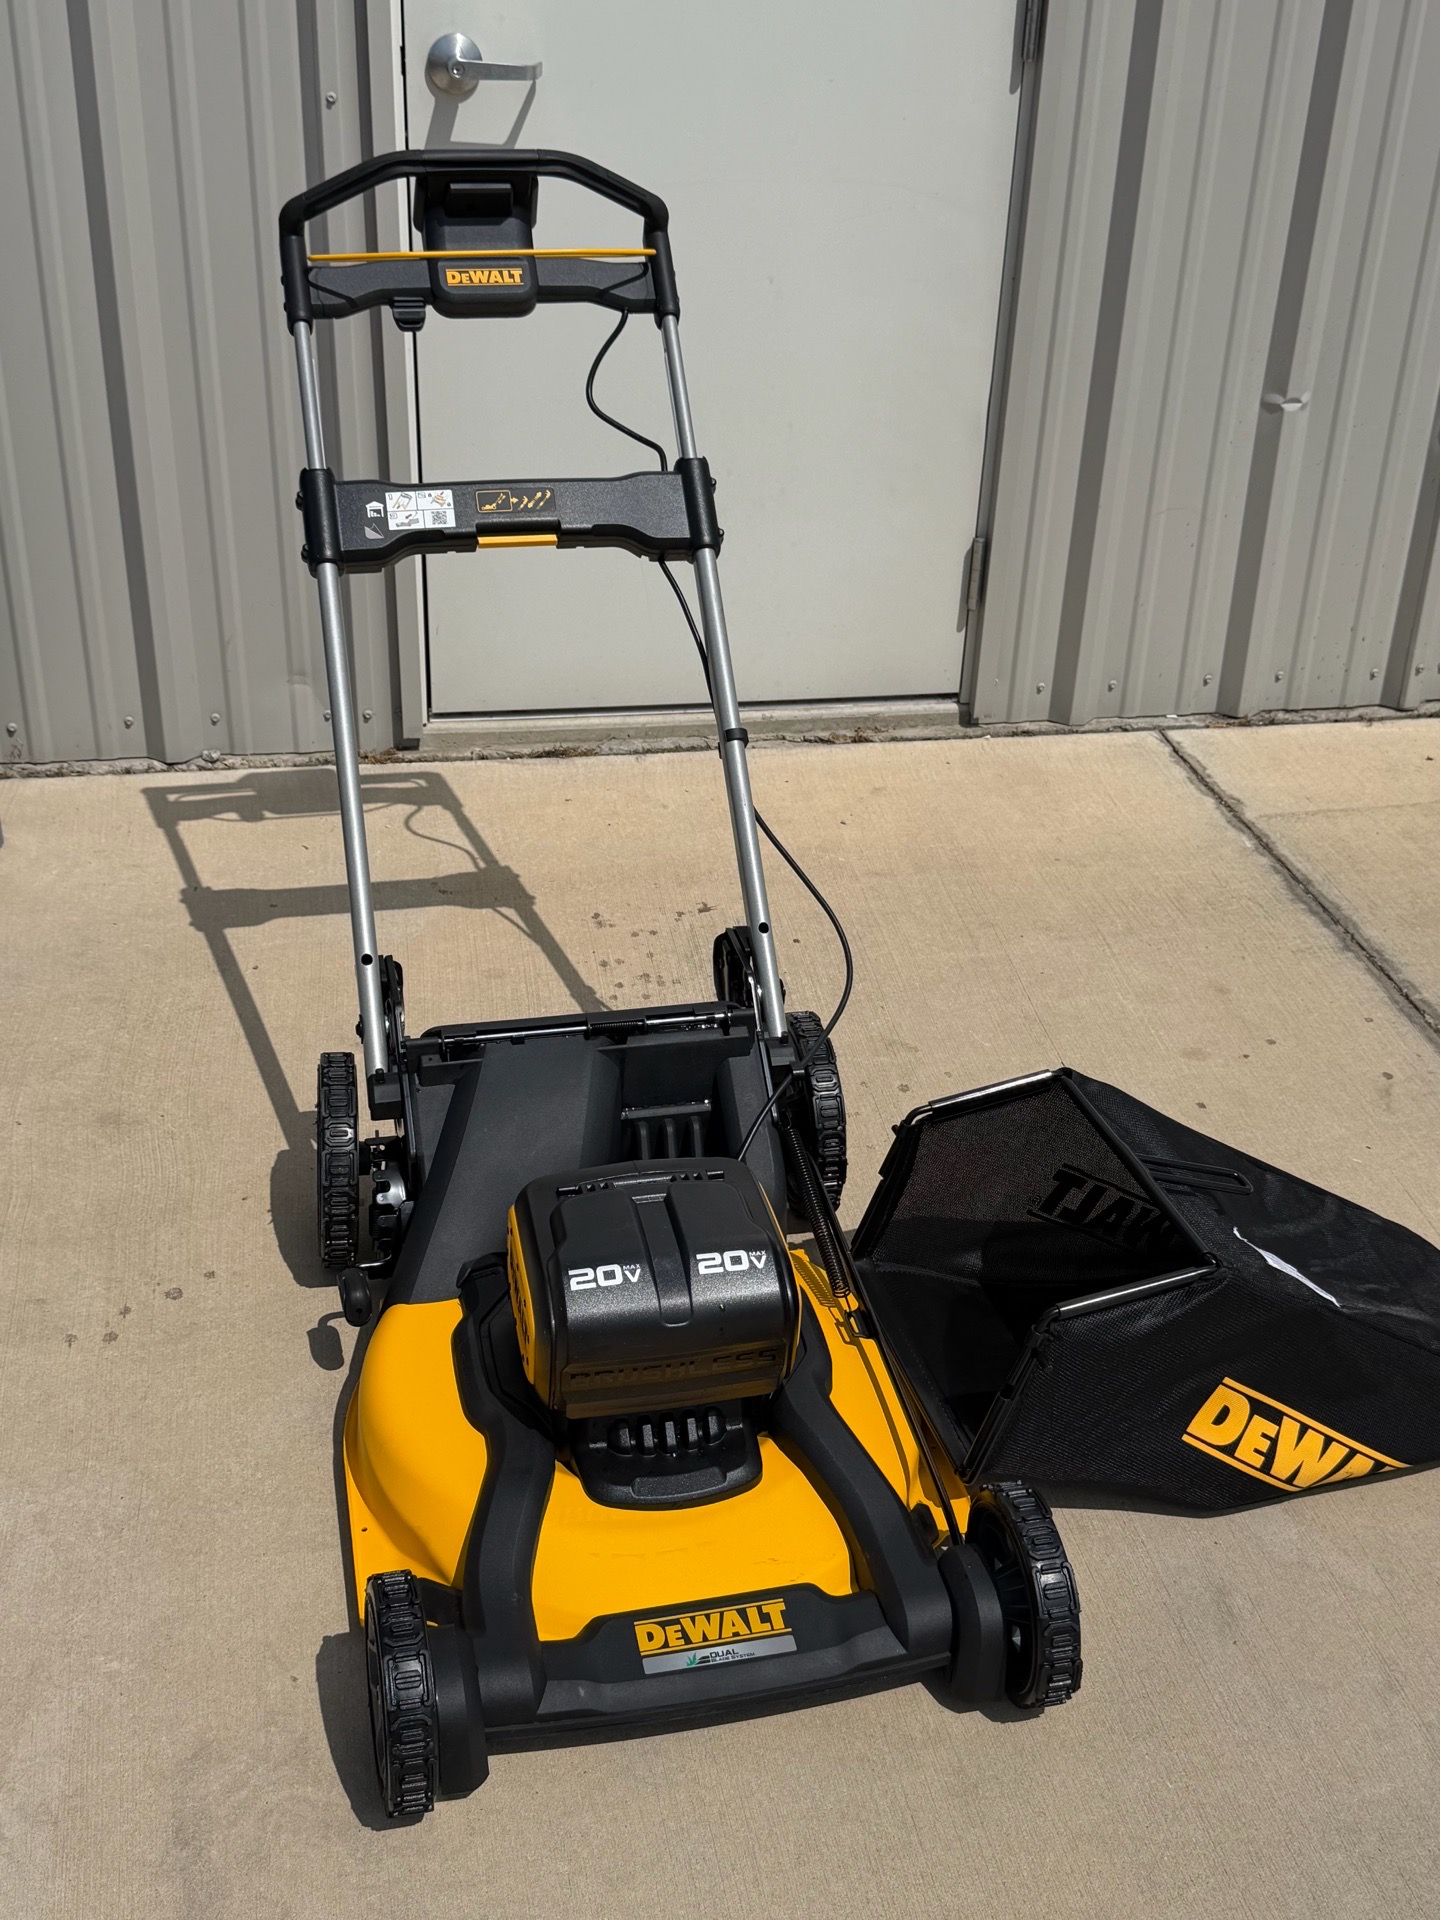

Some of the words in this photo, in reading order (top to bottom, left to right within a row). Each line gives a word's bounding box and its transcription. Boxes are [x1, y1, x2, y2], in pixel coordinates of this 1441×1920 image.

[749, 1249, 767, 1257] MAX
[623, 1263, 641, 1271] MAX
[709, 1648, 740, 1659] DUAL
